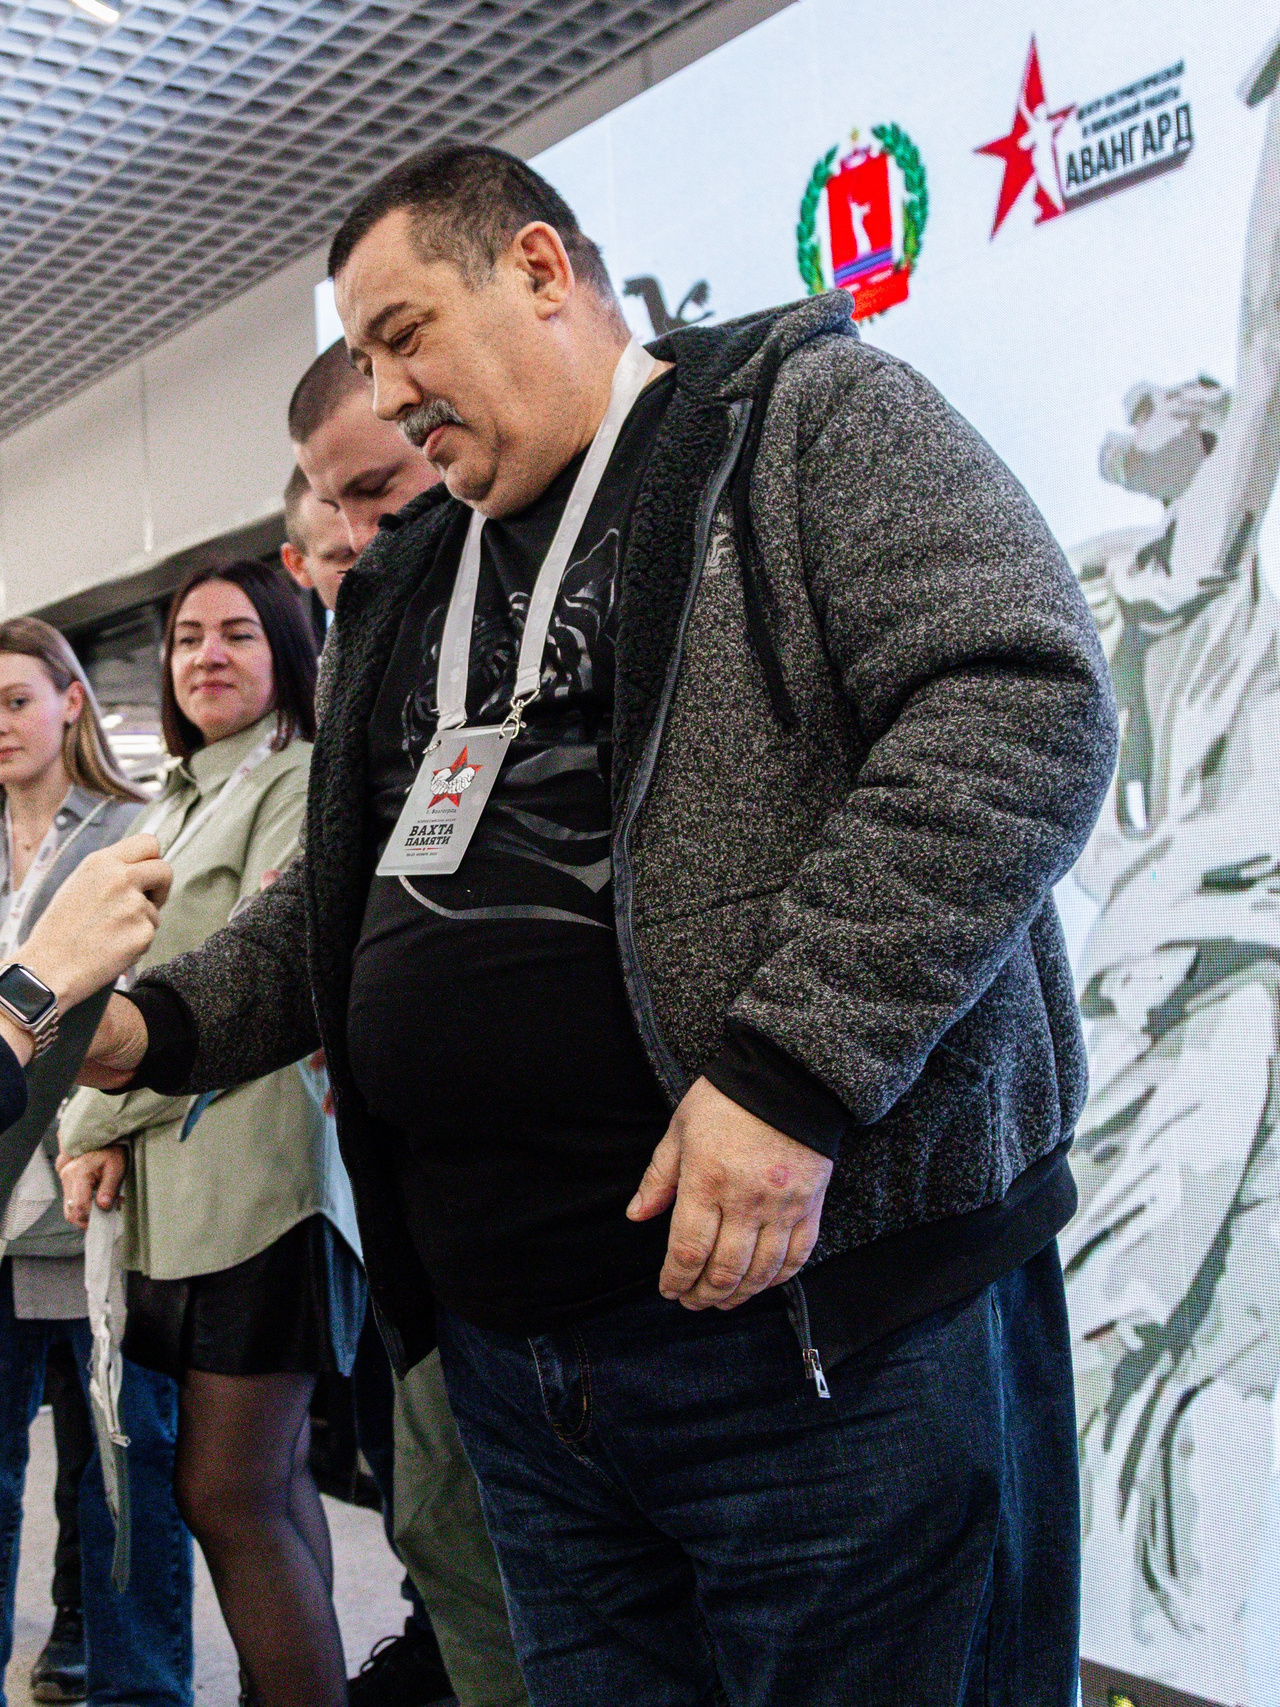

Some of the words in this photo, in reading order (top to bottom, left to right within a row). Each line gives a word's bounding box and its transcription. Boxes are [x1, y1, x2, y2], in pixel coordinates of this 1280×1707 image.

[1066, 102, 1193, 189] АВАНГАРД
[409, 824, 454, 836] ВАХТА
[404, 836, 451, 846] ПАМЯТИ
